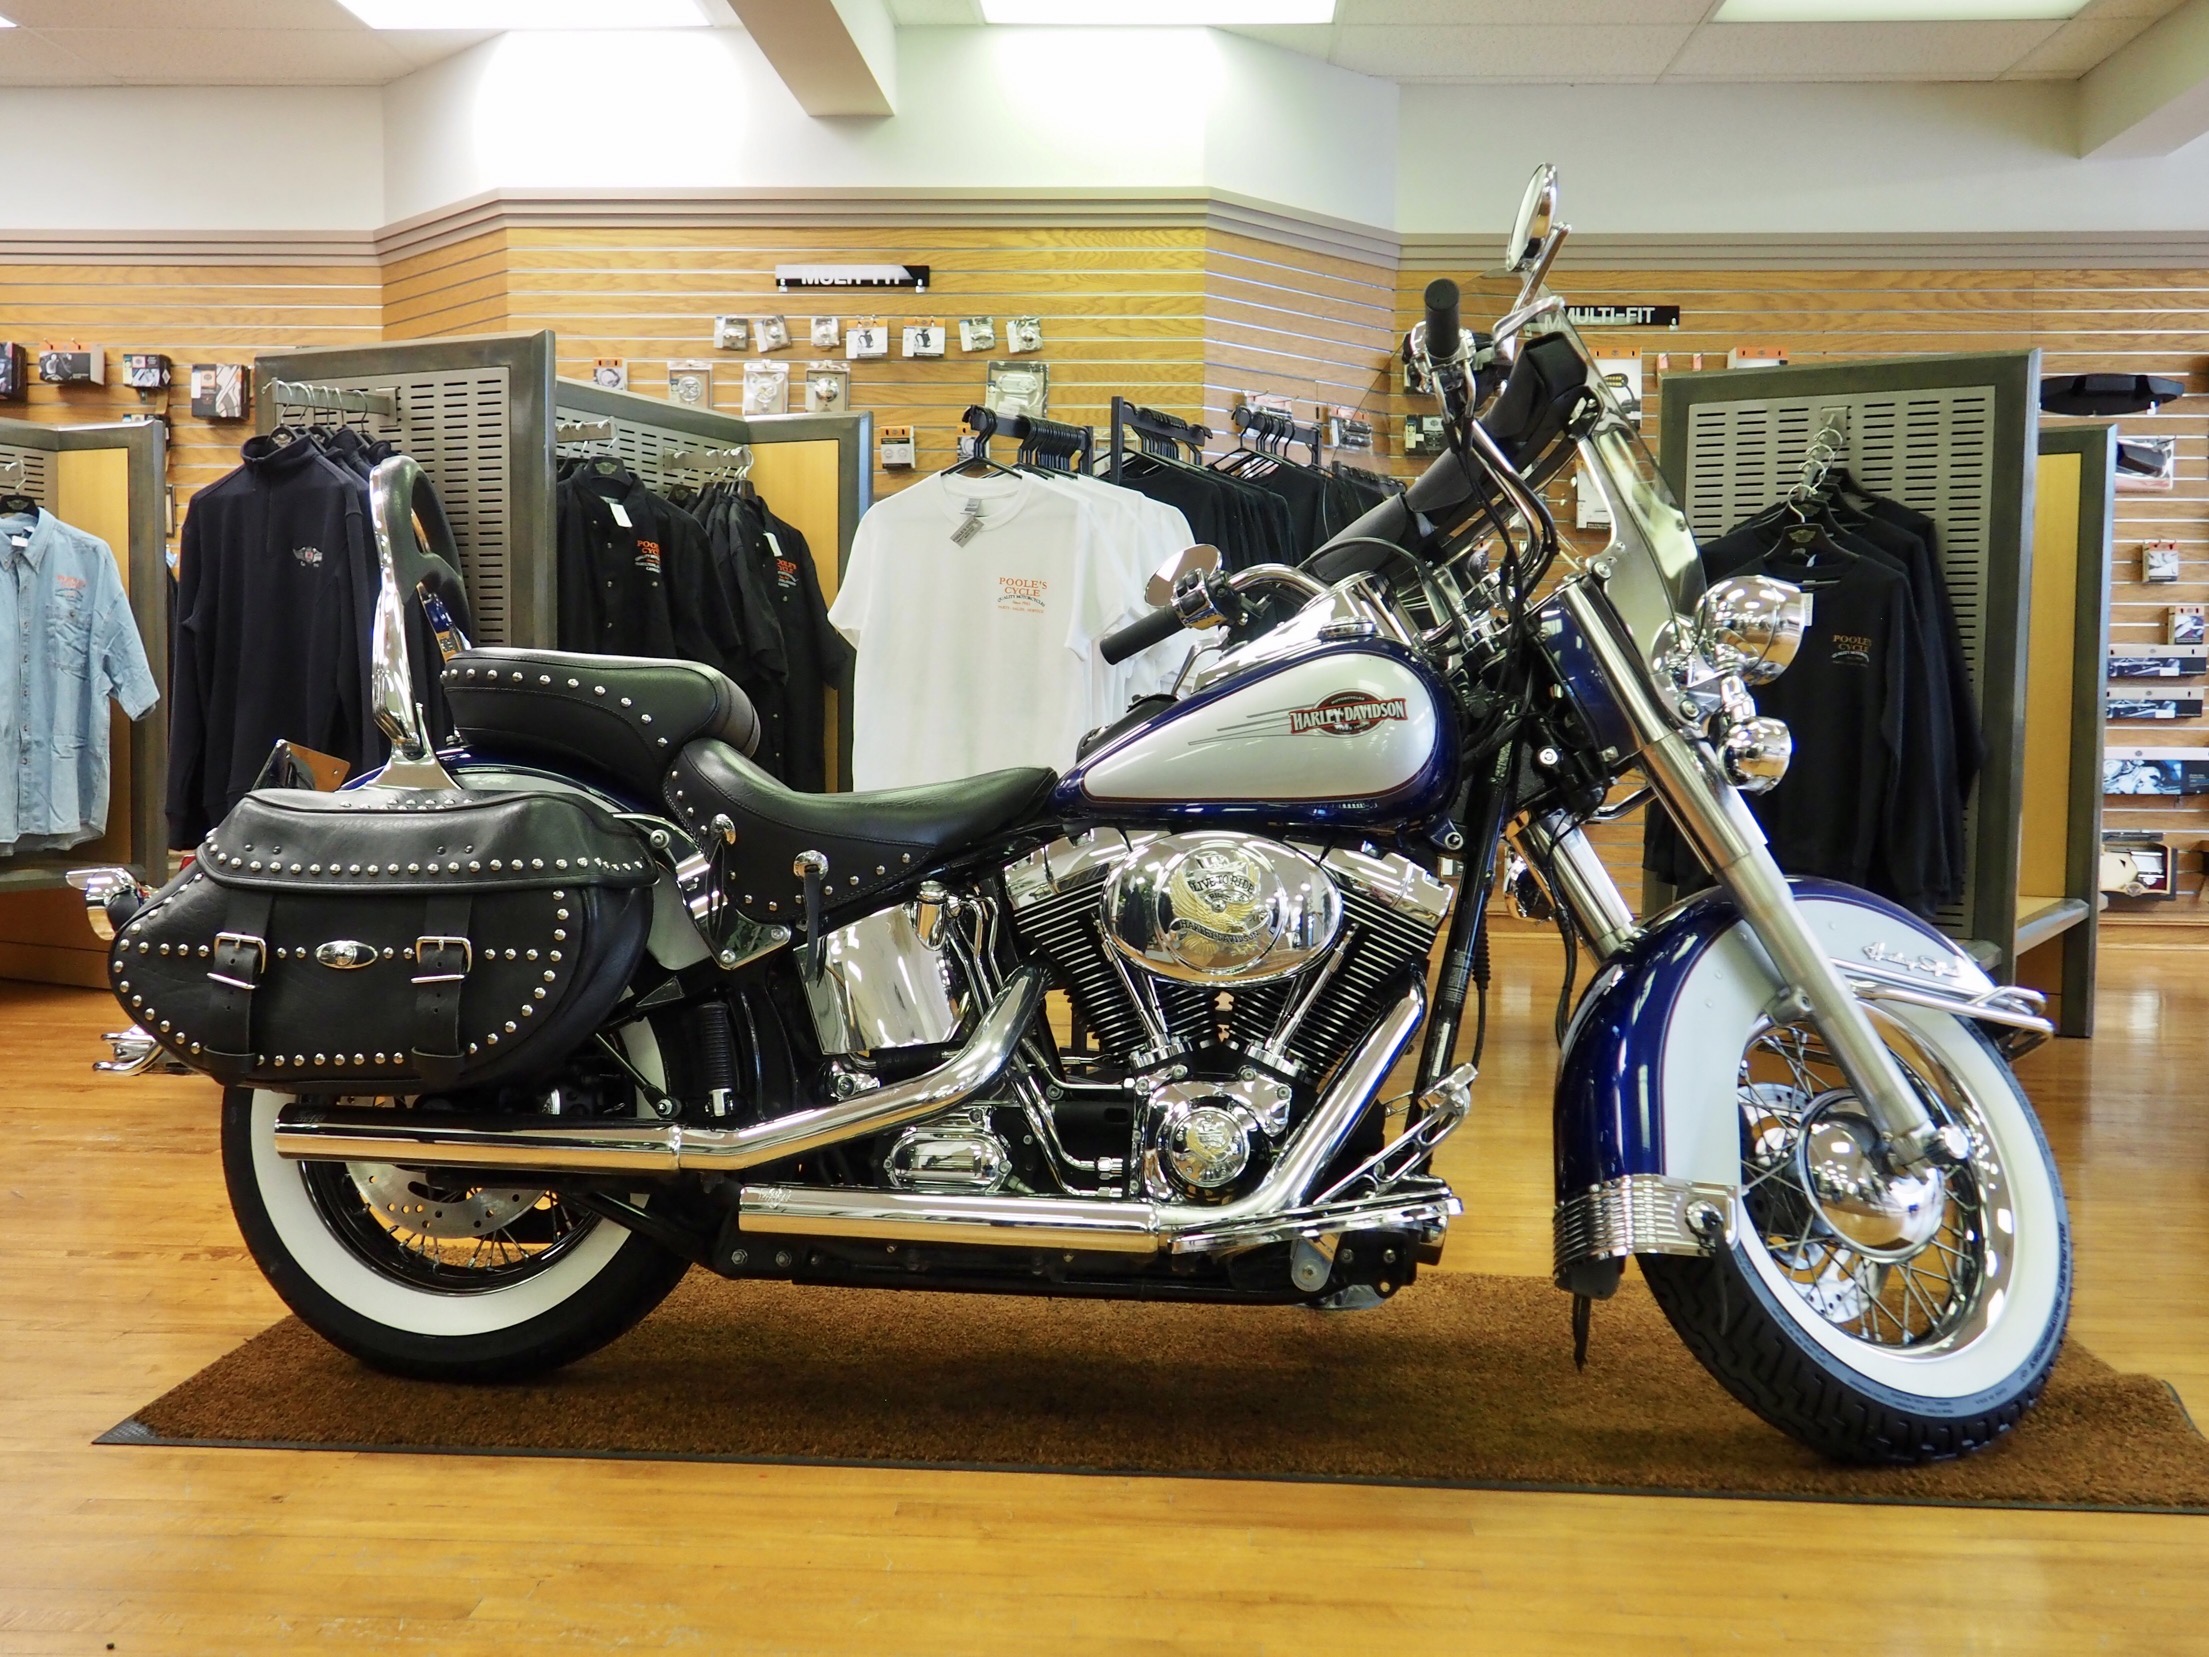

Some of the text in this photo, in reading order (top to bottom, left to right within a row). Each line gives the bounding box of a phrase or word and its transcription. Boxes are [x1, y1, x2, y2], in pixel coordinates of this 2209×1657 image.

[1565, 307, 1656, 324] MULTI-FIT
[999, 577, 1048, 590] POOLE'S
[1004, 586, 1041, 597] CYCLE
[1290, 700, 1405, 731] HARLEY-DAVIDSON
[1192, 874, 1255, 894] LIVE TO RIDE
